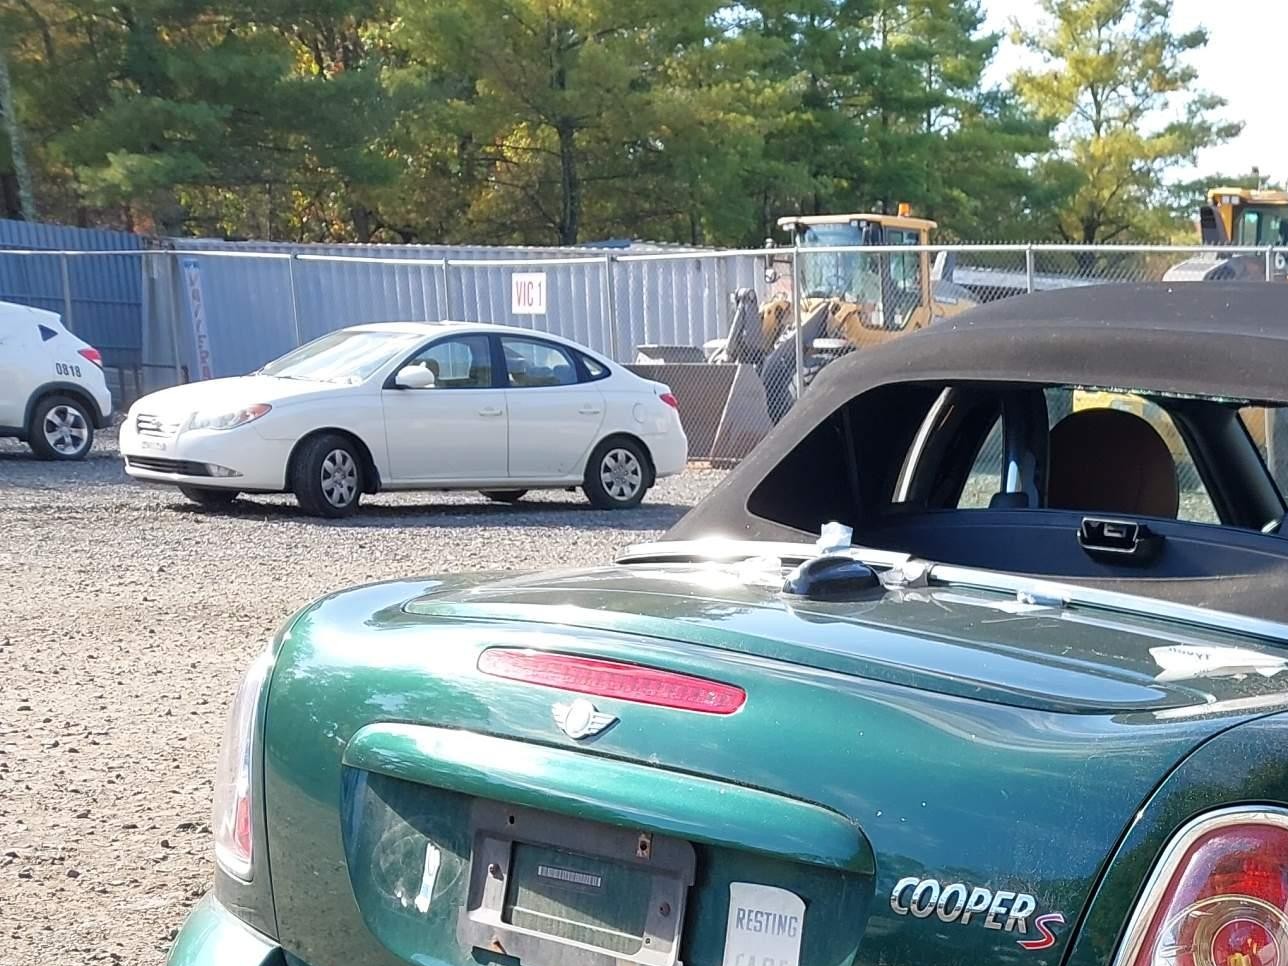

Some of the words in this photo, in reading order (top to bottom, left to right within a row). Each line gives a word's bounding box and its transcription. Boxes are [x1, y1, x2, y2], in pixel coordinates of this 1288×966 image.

[516, 280, 533, 306] VIC
[55, 362, 82, 378] 0818
[736, 907, 798, 937] RESTING
[890, 877, 1036, 934] COOPER
[1016, 912, 1065, 950] S
